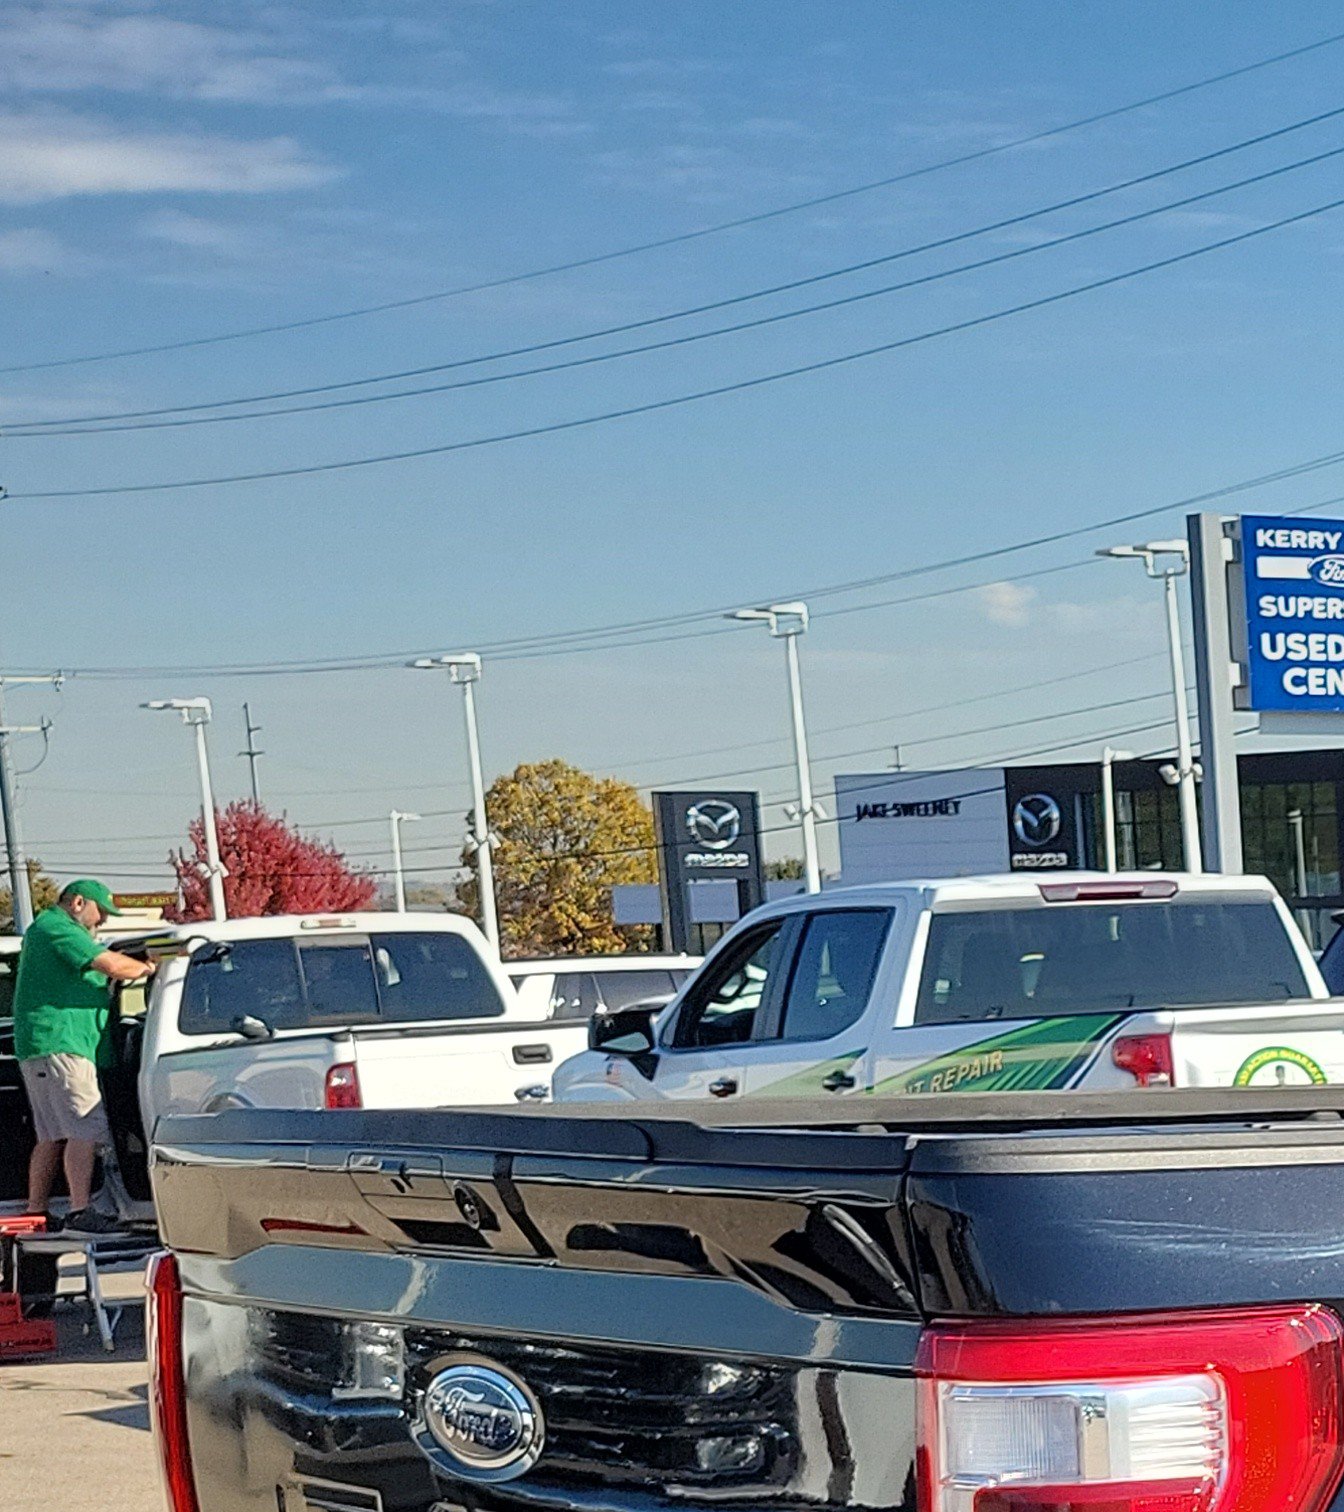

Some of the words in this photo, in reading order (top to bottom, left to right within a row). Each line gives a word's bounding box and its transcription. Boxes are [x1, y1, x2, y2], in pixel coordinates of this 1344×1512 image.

[1256, 528, 1342, 550] KERRY
[930, 1050, 1003, 1093] REPAIR
[443, 1385, 518, 1443] Ford
